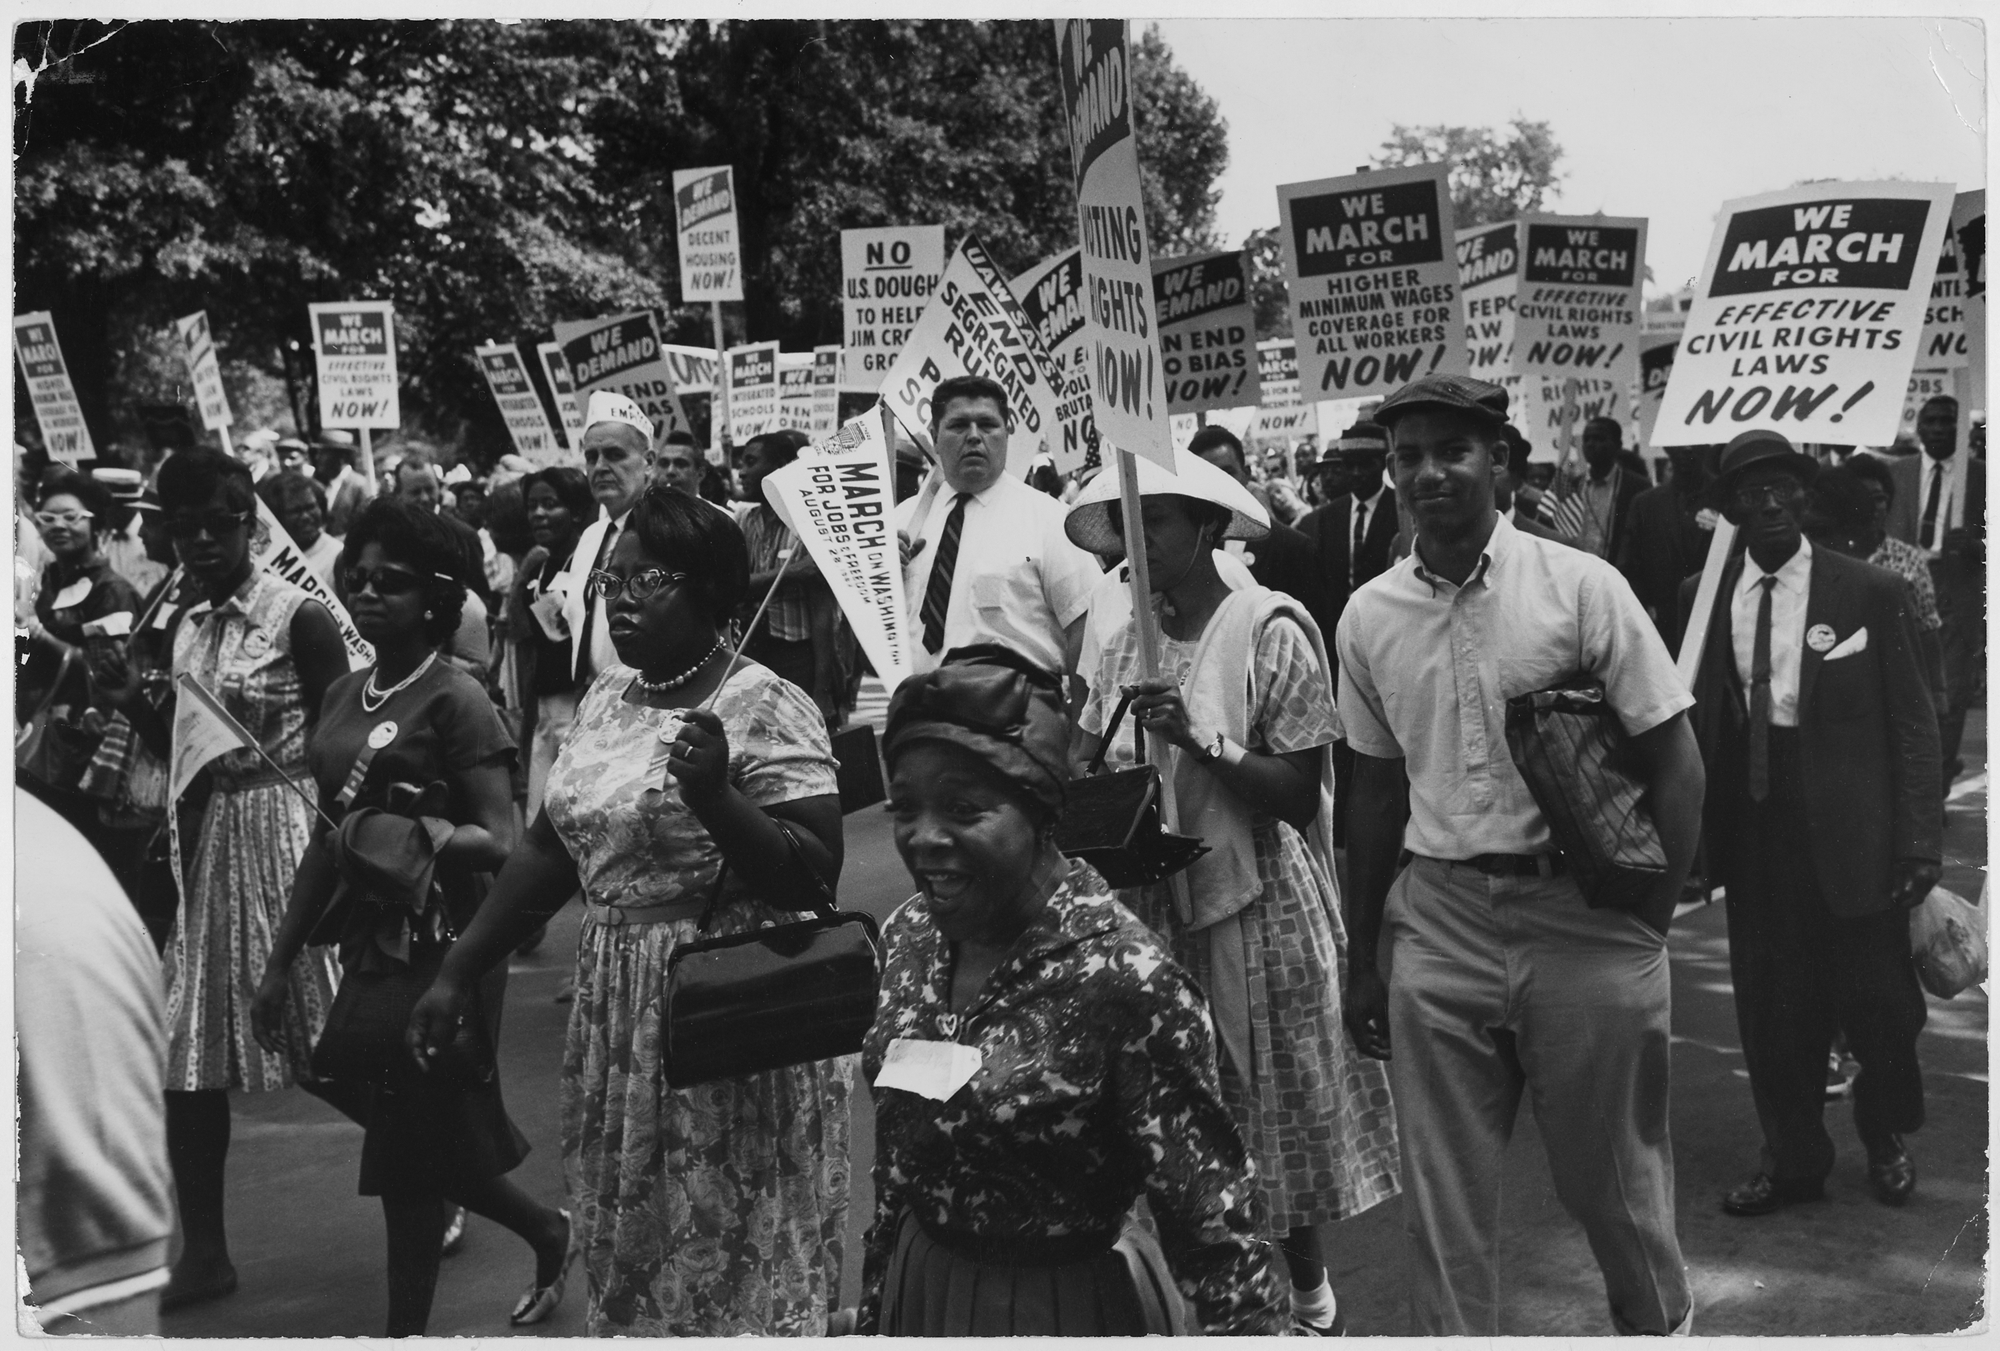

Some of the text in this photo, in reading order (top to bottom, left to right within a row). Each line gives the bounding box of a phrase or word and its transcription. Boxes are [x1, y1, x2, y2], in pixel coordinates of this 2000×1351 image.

[1070, 18, 1093, 86] WE
[1072, 46, 1123, 176] DEMAND
[693, 177, 713, 201] WE
[682, 189, 730, 228] DEMAND
[1341, 193, 1385, 218] WE
[1793, 204, 1853, 231] WE
[688, 230, 730, 246] DECENT
[1080, 204, 1142, 265] VOTING
[1306, 213, 1429, 254] MARCH
[1567, 229, 1599, 247] WE
[685, 252, 736, 267] HOUSING
[866, 241, 911, 266] NO
[1345, 249, 1393, 266] FOR
[1534, 248, 1627, 271] MARCH
[1726, 232, 1905, 272] MARCH
[691, 268, 735, 290] NOW!
[847, 274, 939, 298] U.S. DOUGH
[966, 247, 1012, 304] UAW
[1038, 263, 1071, 312] WE
[1163, 264, 1205, 296] WE
[1327, 269, 1420, 295] HIGHER
[1561, 270, 1598, 282] FOR
[1772, 268, 1840, 286] FOR
[1088, 272, 1148, 339] RIGHTS
[1300, 284, 1454, 319] MINIMUM WAGES
[1532, 288, 1628, 307] EFFECTIVE
[340, 314, 362, 328] WE
[856, 307, 876, 325] TO
[1308, 307, 1450, 337] COVERAGE FOR
[1518, 305, 1633, 325] CIVIL RIGHTS
[1715, 298, 1896, 326] EFFECTIVE
[324, 327, 383, 345] MARCH
[590, 325, 622, 354] WE
[850, 329, 876, 347] JIM
[968, 291, 1037, 386] END
[1160, 326, 1246, 353] N END
[1316, 325, 1446, 354] ALL WORKERS
[1547, 324, 1600, 339] LAWS
[1686, 326, 1902, 355] CIVIL RIGHTS
[341, 345, 366, 355] FOR
[576, 336, 655, 383] DEMAND
[745, 352, 759, 363] WE
[940, 281, 1041, 434] SEGREGATED
[1164, 349, 1247, 375] O BIAS
[1263, 350, 1282, 361] WE
[1527, 342, 1624, 369] NOW!
[328, 361, 386, 371] EFFECTIVE
[733, 361, 772, 379] MARCH
[1321, 343, 1446, 391] NOW!
[1731, 354, 1829, 377] LAWS
[322, 374, 392, 385] CIVIL RIGHTS
[340, 387, 373, 397] LAWS
[744, 377, 760, 385] FOR
[1095, 339, 1153, 421] NOW!
[331, 399, 389, 418] NOW!
[732, 404, 775, 418] SCHOOLS
[1684, 380, 1875, 426] NOW!
[735, 418, 773, 437] NOW!
[791, 418, 811, 430] BIA
[1259, 411, 1307, 431] NOW!
[799, 488, 833, 543] AUGUST
[835, 462, 887, 550] MARCH
[868, 552, 884, 570] ON
[807, 465, 836, 495] FOR
[822, 500, 851, 544] JOBS
[844, 553, 872, 605] FREEDOM
[270, 545, 336, 610] MARC
